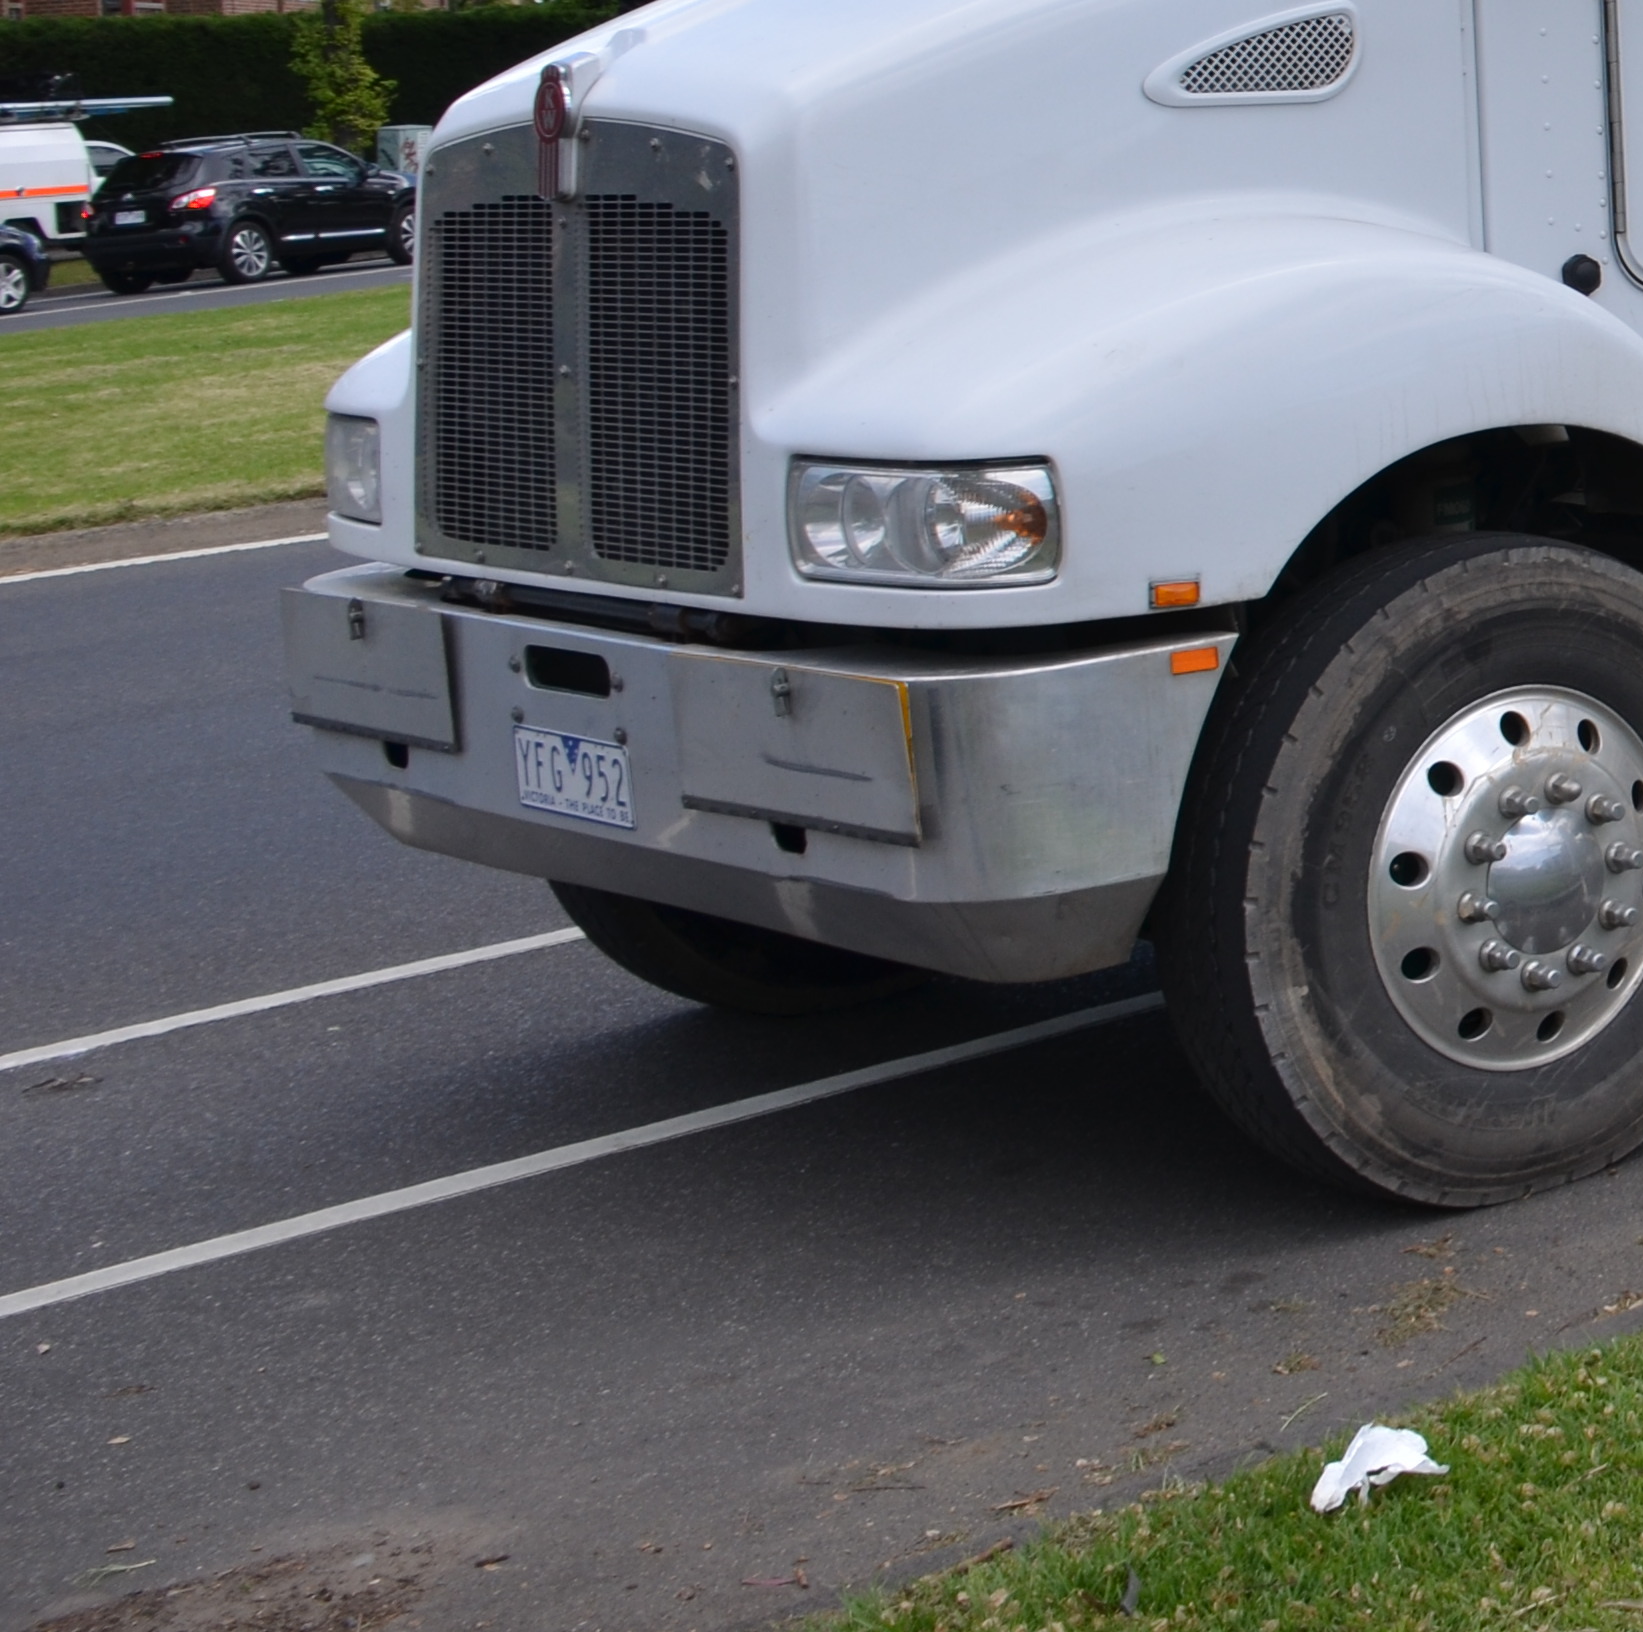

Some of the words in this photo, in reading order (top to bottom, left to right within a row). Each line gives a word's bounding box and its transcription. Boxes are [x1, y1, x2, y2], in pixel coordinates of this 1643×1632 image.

[518, 738, 563, 793] YFG
[582, 752, 627, 807] 952
[523, 790, 556, 806] VICTORIA
[565, 797, 579, 812] THE
[582, 802, 604, 817] PLACE
[607, 807, 617, 821] TO
